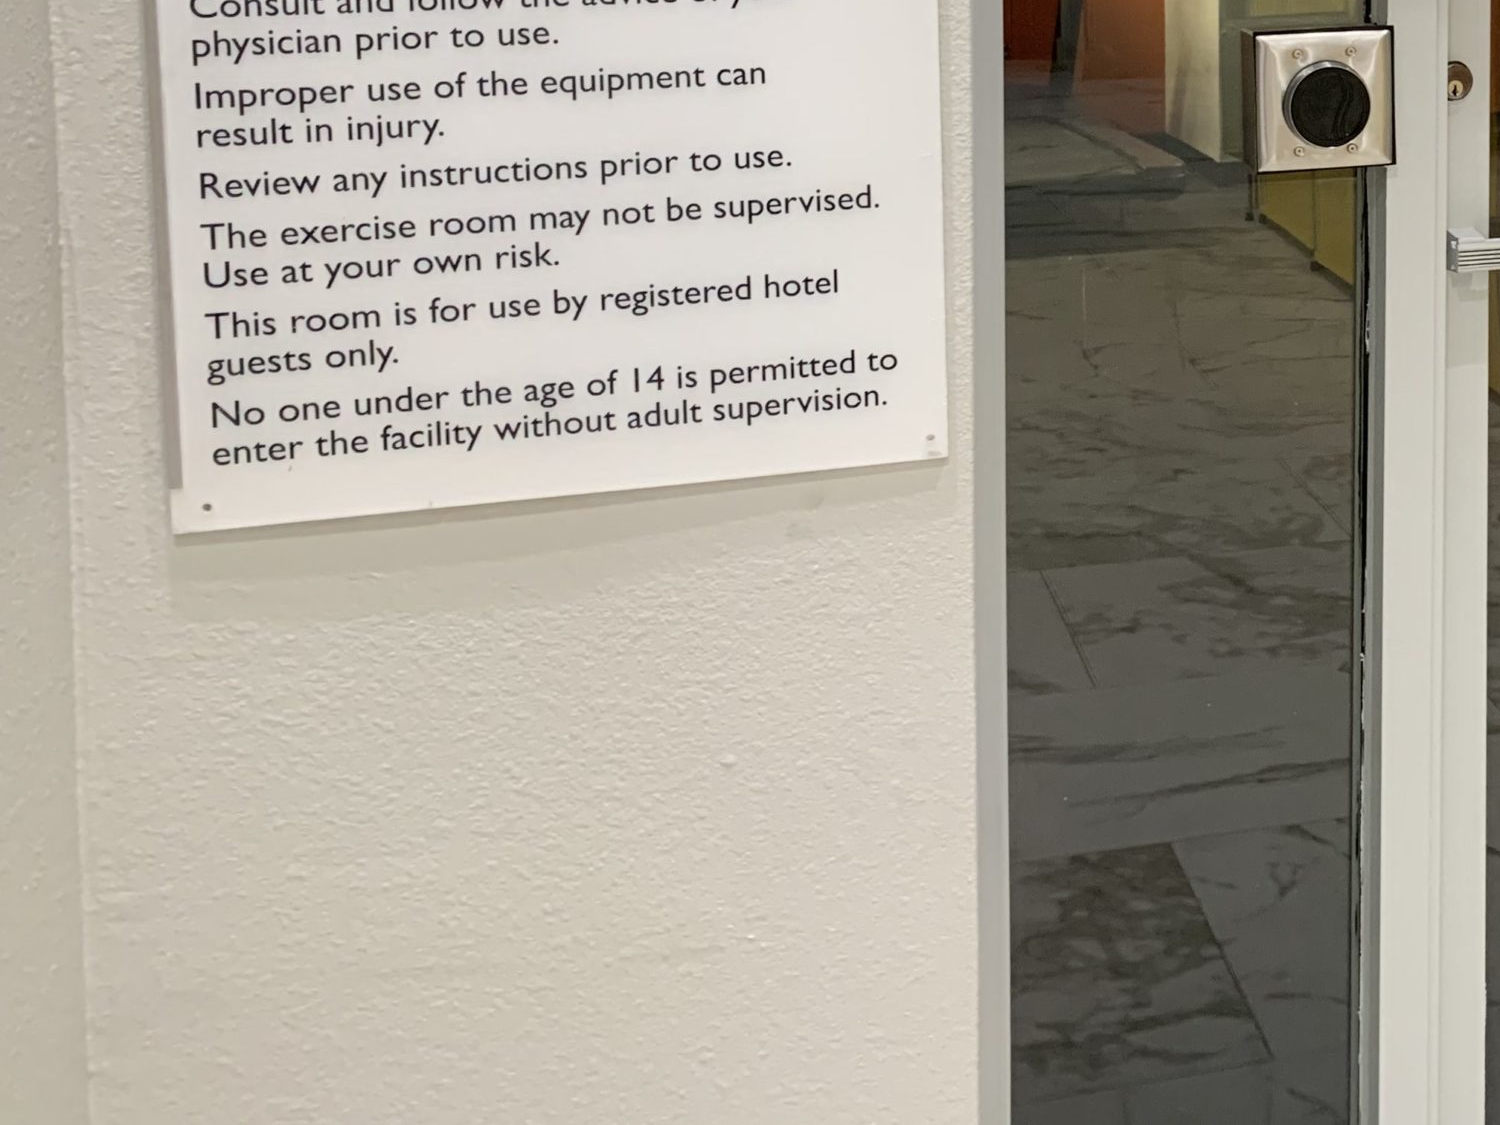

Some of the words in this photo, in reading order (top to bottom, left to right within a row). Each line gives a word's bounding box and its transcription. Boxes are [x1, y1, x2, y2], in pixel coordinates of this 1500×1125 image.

[192, 29, 341, 66] physician
[356, 26, 438, 60] prior
[450, 28, 484, 48] to
[498, 27, 558, 46] use.
[195, 83, 354, 116] Improper
[368, 82, 421, 101] use
[434, 72, 467, 98] of
[477, 71, 527, 97] the
[541, 68, 706, 101] equipment
[717, 67, 765, 86] can
[197, 118, 293, 148] result
[306, 118, 332, 142] in
[348, 115, 444, 147] injury.
[200, 171, 320, 199] Review
[333, 172, 387, 198] any
[401, 158, 587, 188] instructions
[601, 152, 678, 185] prior
[689, 153, 721, 172] to
[735, 150, 791, 169] use.
[200, 223, 267, 250] The
[281, 216, 416, 245] exercise
[430, 214, 516, 236] room
[530, 210, 590, 235] may
[603, 204, 655, 226] not
[667, 197, 701, 222] be
[714, 184, 879, 224] supervised.
[204, 261, 268, 288] Use
[282, 262, 313, 283] at
[324, 259, 400, 289] your
[414, 254, 481, 274] own
[496, 242, 559, 269] risk.
[204, 312, 276, 339] This
[291, 310, 380, 333] room
[395, 302, 417, 326] is
[429, 297, 476, 323] for
[489, 299, 540, 319] use
[554, 289, 587, 321] by
[601, 275, 751, 316] registered
[765, 269, 838, 298] hotel
[207, 352, 311, 386] guests
[326, 339, 398, 373] only.
[212, 400, 265, 428] No
[279, 401, 340, 422] one
[355, 386, 449, 417] under
[461, 381, 512, 407] the
[524, 382, 574, 408] age
[587, 369, 618, 396] of
[634, 366, 664, 393] 14
[677, 366, 697, 389] is
[710, 349, 855, 394] permitted
[867, 353, 897, 371] to
[213, 441, 303, 465] enter
[315, 430, 368, 456] the
[380, 421, 482, 451] facility
[493, 411, 616, 440] without
[627, 399, 702, 429] adult
[712, 388, 887, 426] supervision.
